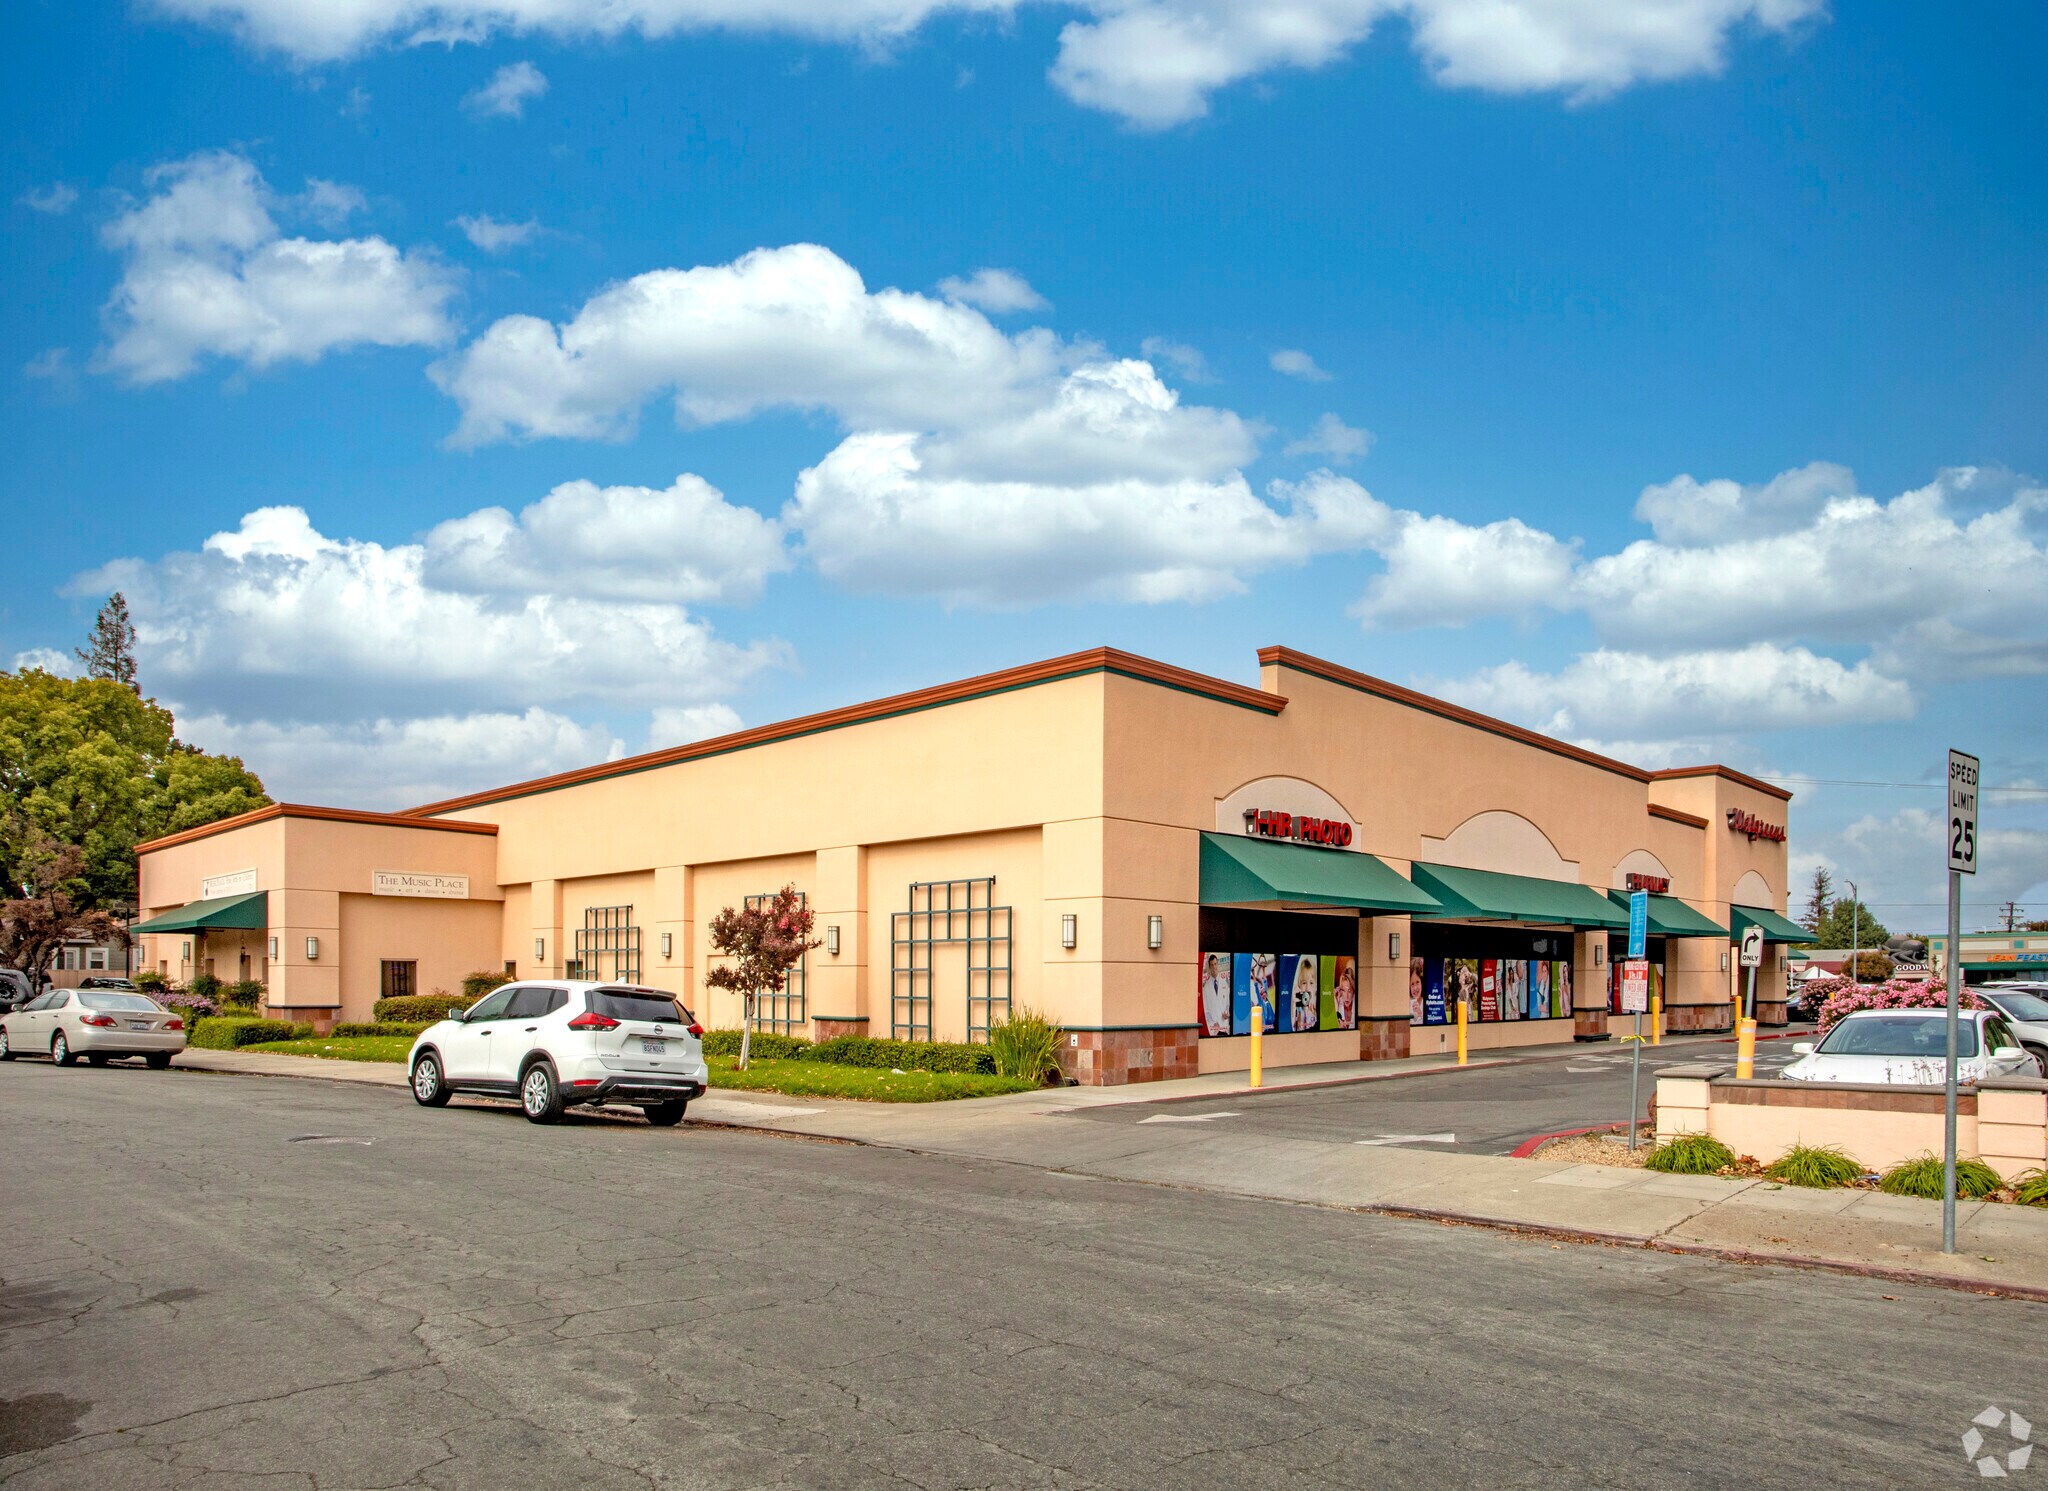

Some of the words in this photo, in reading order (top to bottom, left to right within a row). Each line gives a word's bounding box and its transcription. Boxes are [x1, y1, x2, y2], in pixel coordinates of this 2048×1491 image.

[1950, 762, 1977, 786] SPEED
[1952, 789, 1974, 812] LIMIT
[1243, 808, 1292, 837] 1-HR
[1299, 815, 1353, 847] PHOTO
[1726, 807, 1787, 842] Walgreens
[1951, 817, 1974, 862] 25
[1627, 872, 1671, 893] PHARMACY
[1742, 954, 1759, 962] ONLY
